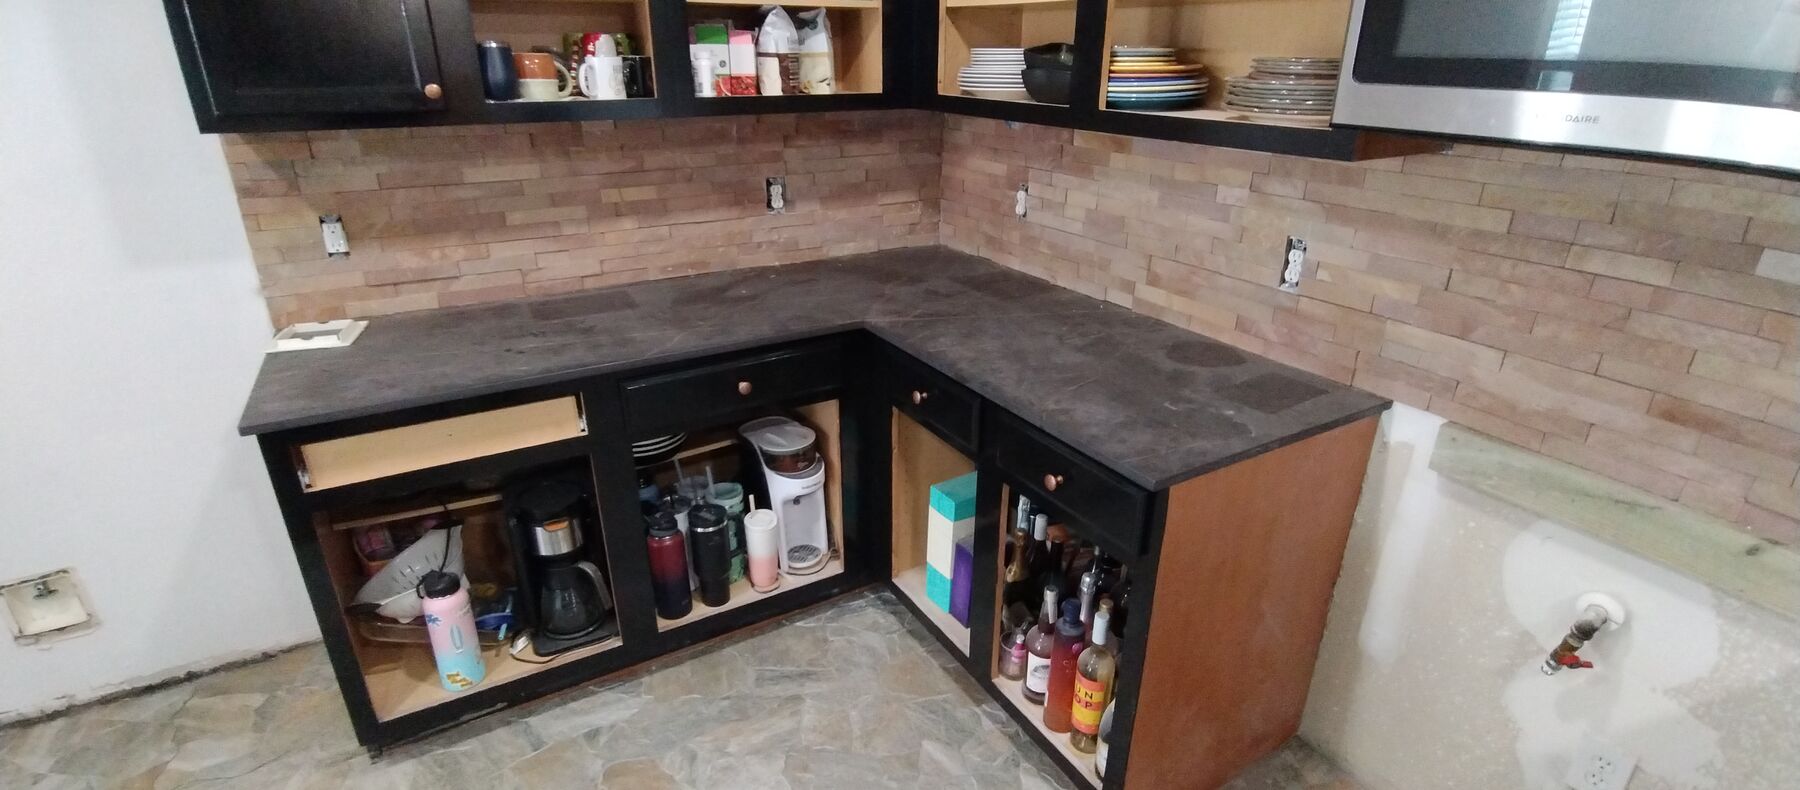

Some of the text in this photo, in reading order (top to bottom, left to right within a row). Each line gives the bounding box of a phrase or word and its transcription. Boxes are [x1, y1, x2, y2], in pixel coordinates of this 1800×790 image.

[1560, 114, 1600, 124] DAIRE
[1076, 683, 1093, 700] UN
[1074, 693, 1093, 709] OP
